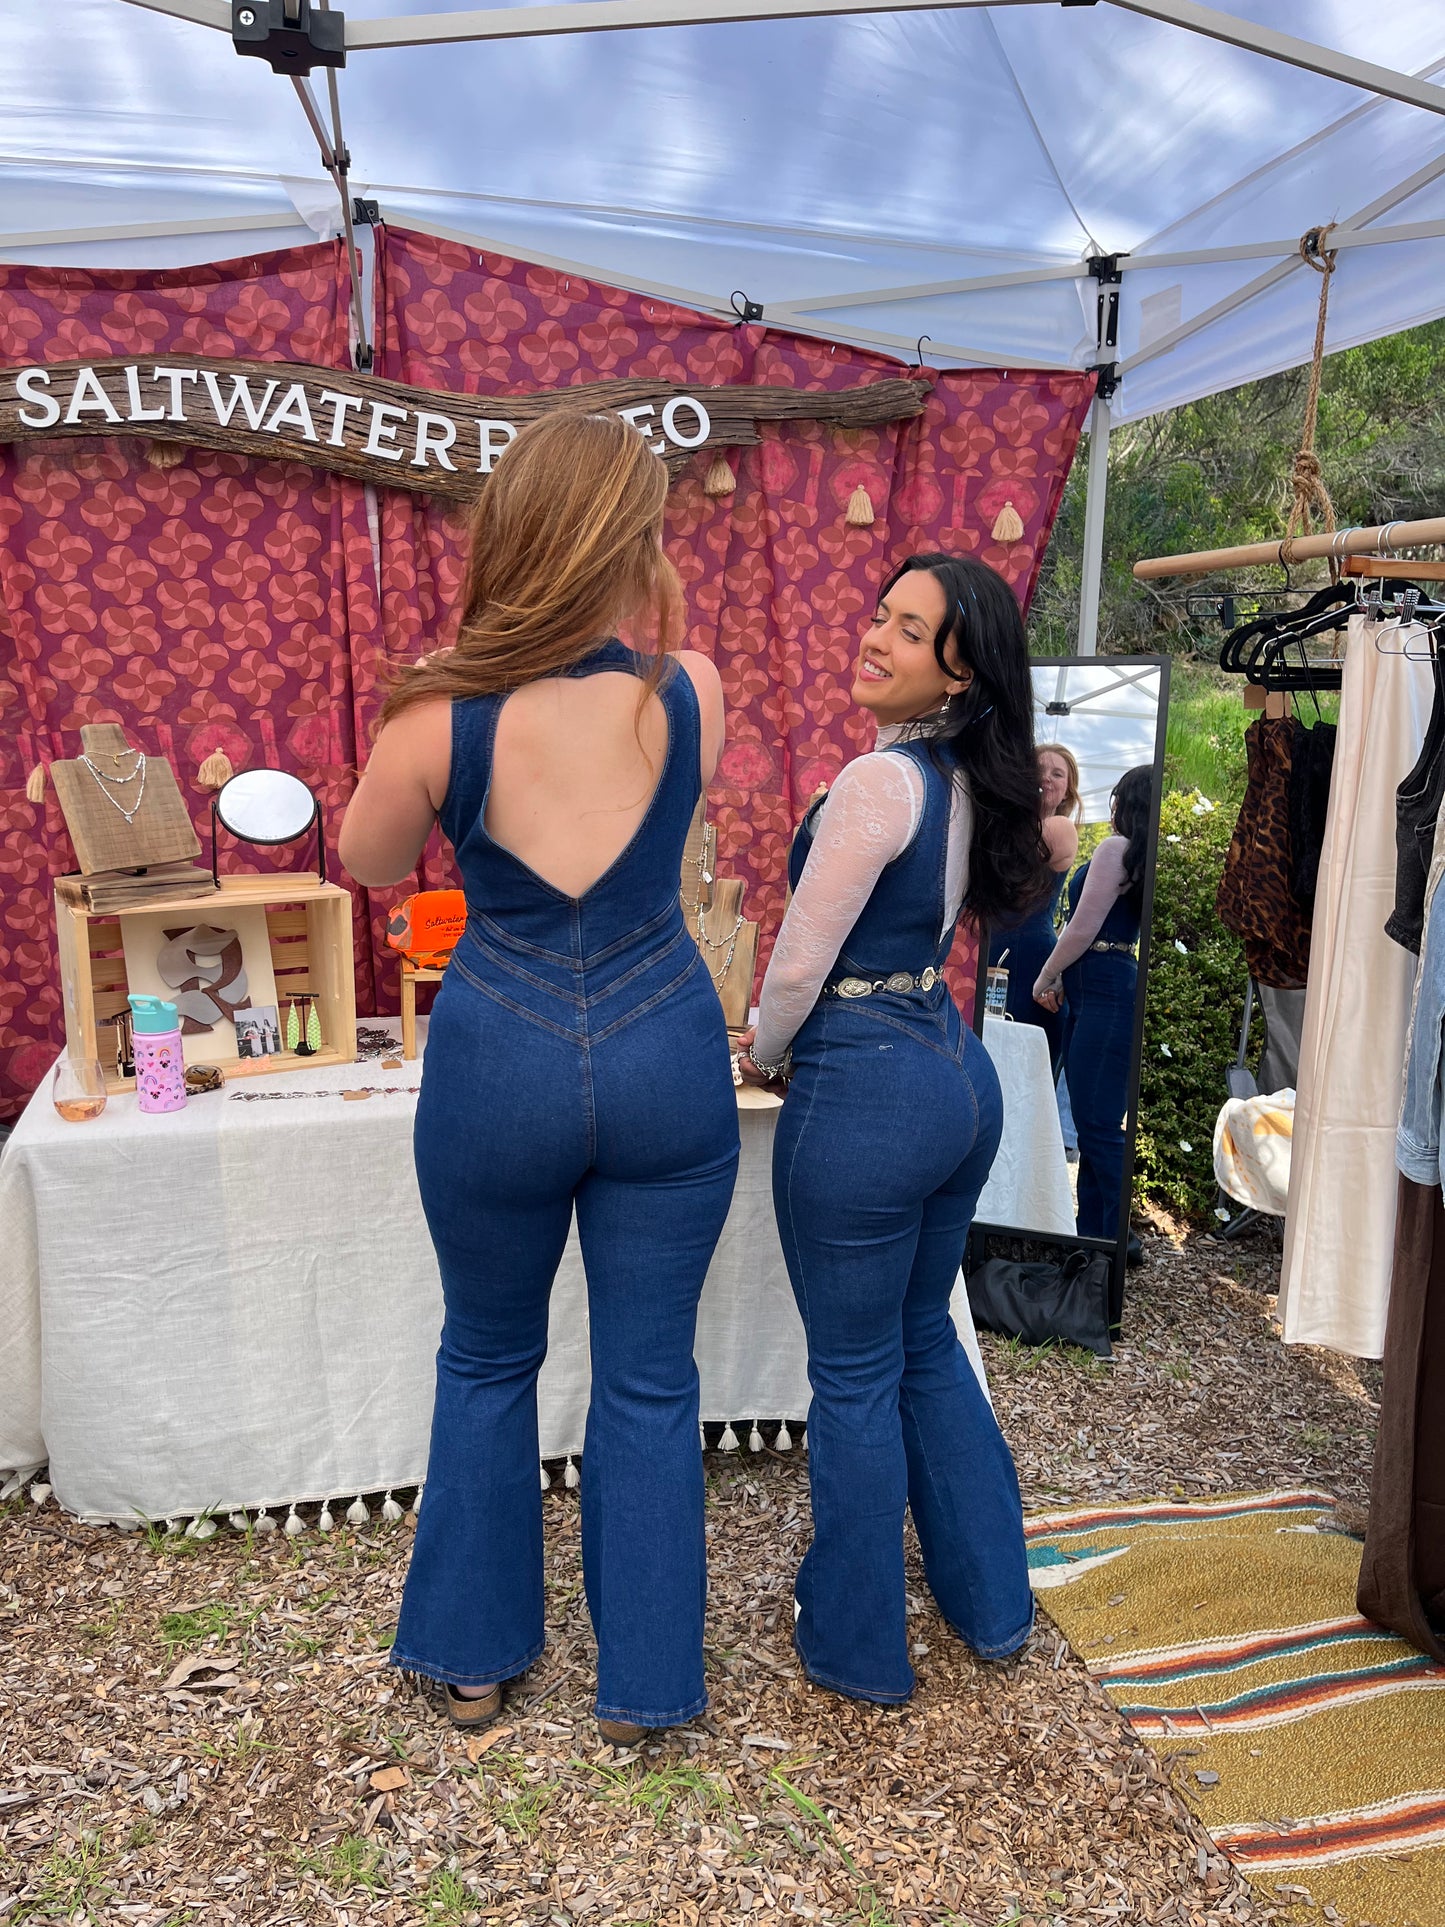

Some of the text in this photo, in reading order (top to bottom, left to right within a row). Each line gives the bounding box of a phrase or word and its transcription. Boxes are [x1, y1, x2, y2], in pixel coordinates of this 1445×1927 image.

[15, 365, 711, 473] SALTWATER REO
[425, 914, 465, 930] Saltwater
